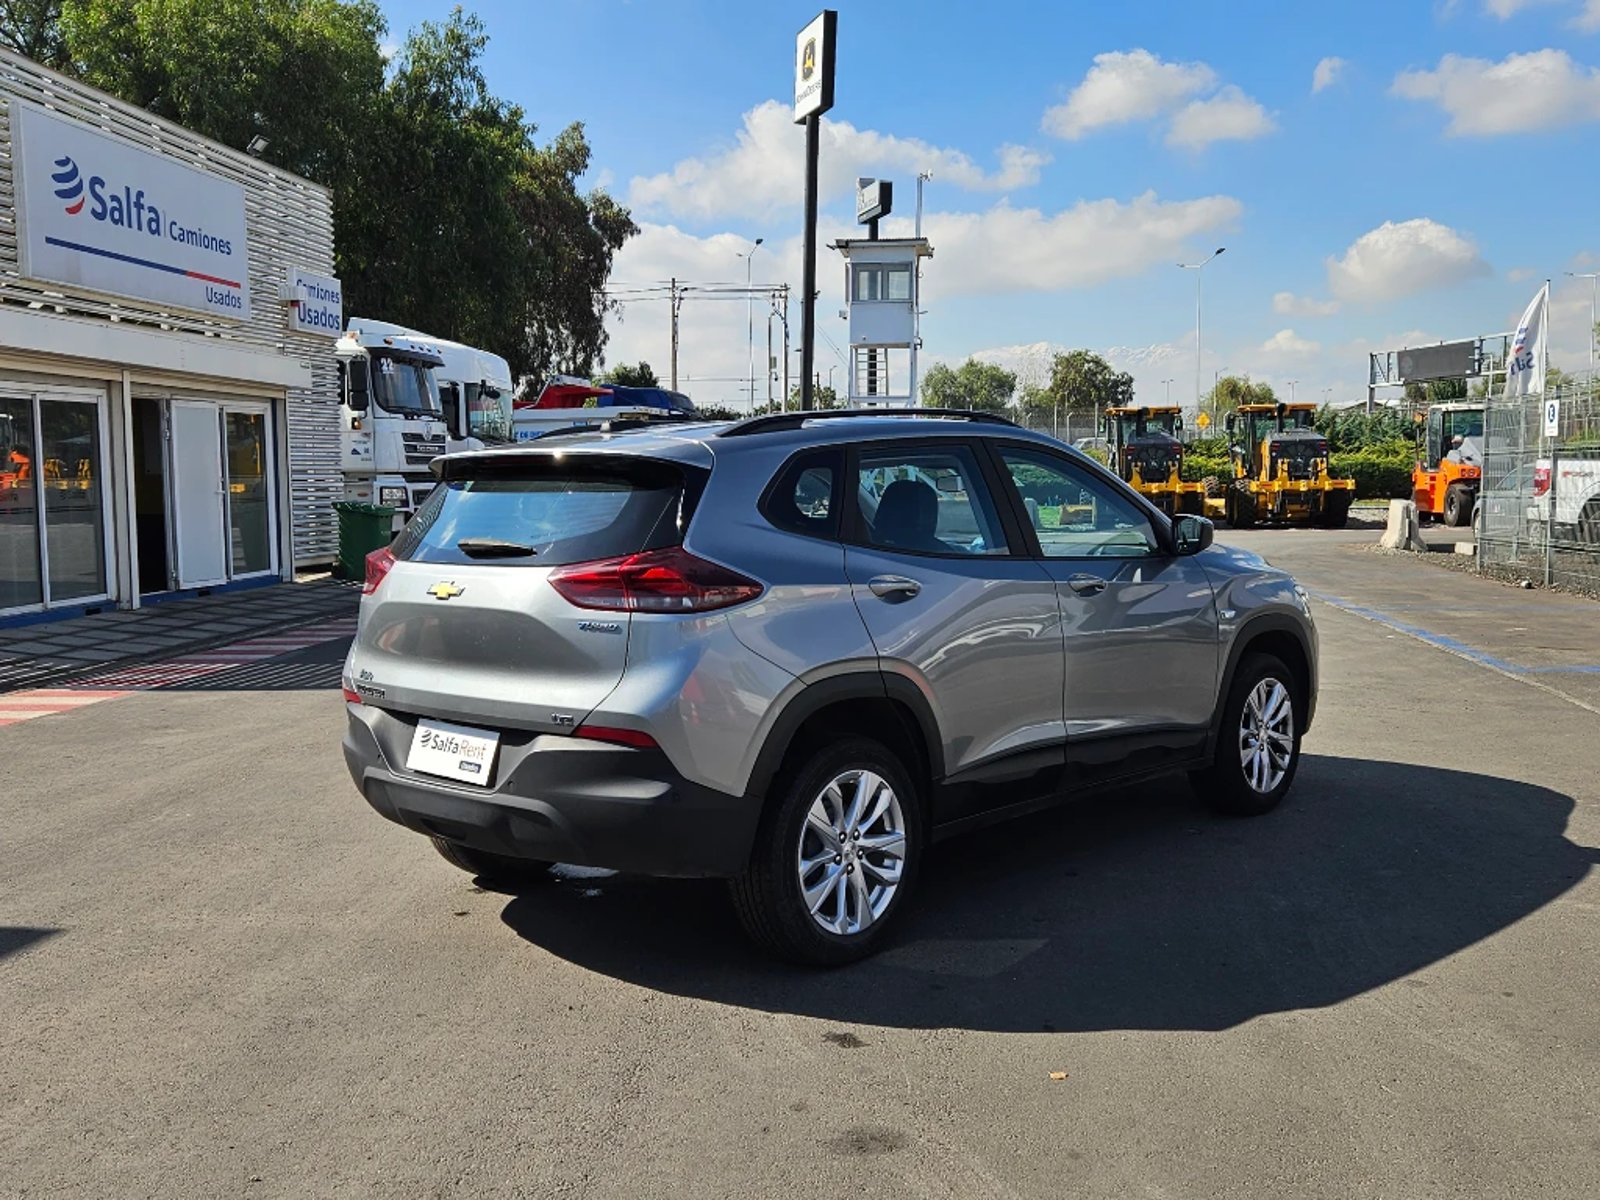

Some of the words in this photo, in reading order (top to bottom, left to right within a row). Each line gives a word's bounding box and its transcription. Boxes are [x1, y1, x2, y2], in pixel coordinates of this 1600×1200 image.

[88, 175, 161, 237] Salfa
[169, 220, 233, 256] Camiones
[205, 285, 243, 309] Usados
[297, 302, 340, 331] Usados
